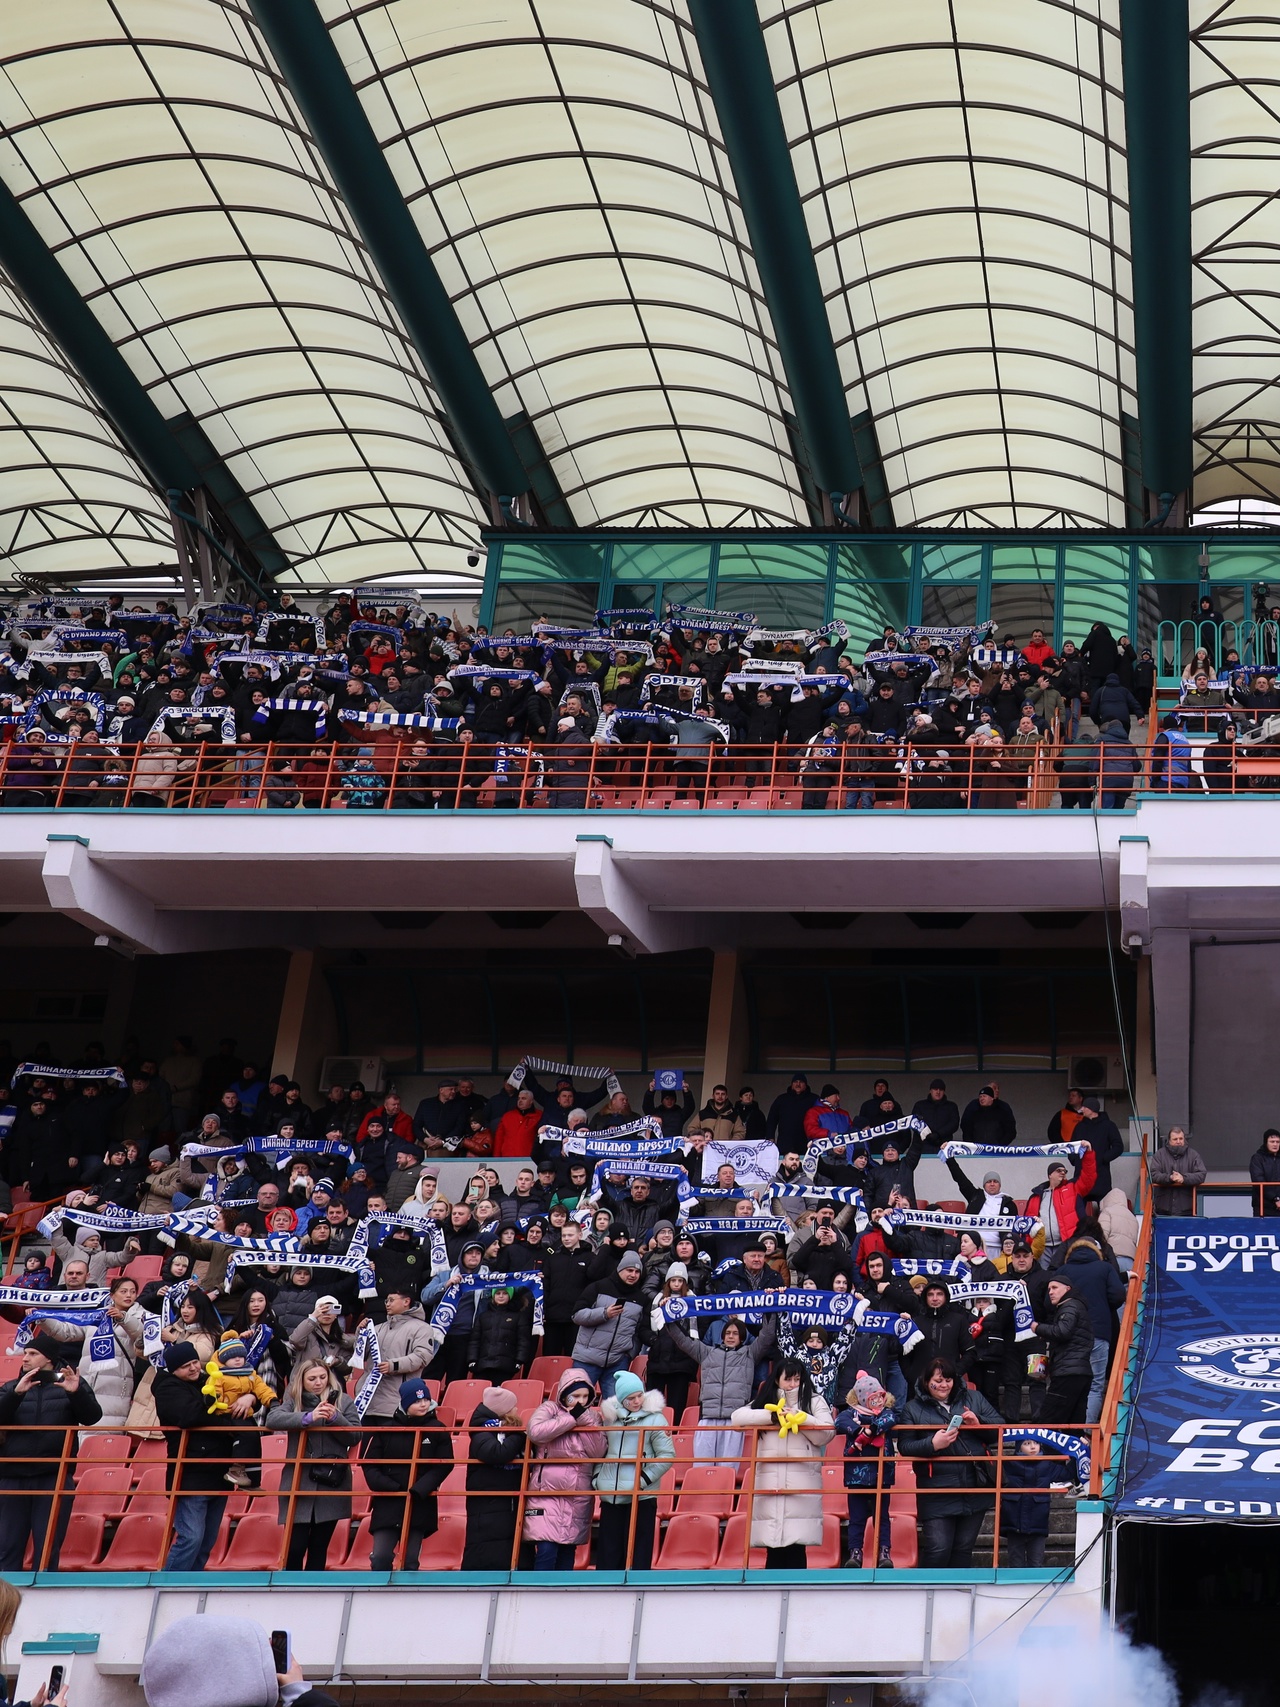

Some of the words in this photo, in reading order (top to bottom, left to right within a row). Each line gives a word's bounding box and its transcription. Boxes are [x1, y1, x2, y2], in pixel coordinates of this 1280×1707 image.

[32, 1065, 110, 1076] ДИНАМО-БРЕСТ
[586, 1141, 631, 1152] ДИНАМО
[636, 1139, 673, 1151] БРЕСТ
[984, 1145, 1033, 1154] DYNAMO
[610, 1161, 646, 1171] ДИНАМО
[648, 1163, 675, 1174] БРЕСТ
[75, 1213, 166, 1229] ДИНАМО-БРЕС
[744, 1218, 778, 1229] БУГОМ
[1167, 1235, 1280, 1251] ГОРОД
[694, 1298, 713, 1311] FC
[715, 1294, 774, 1310] DYNAMO
[778, 1293, 824, 1308] BREST
[860, 1314, 890, 1329] REST
[1179, 1355, 1202, 1363] 19
[1066, 1439, 1087, 1457] FC
